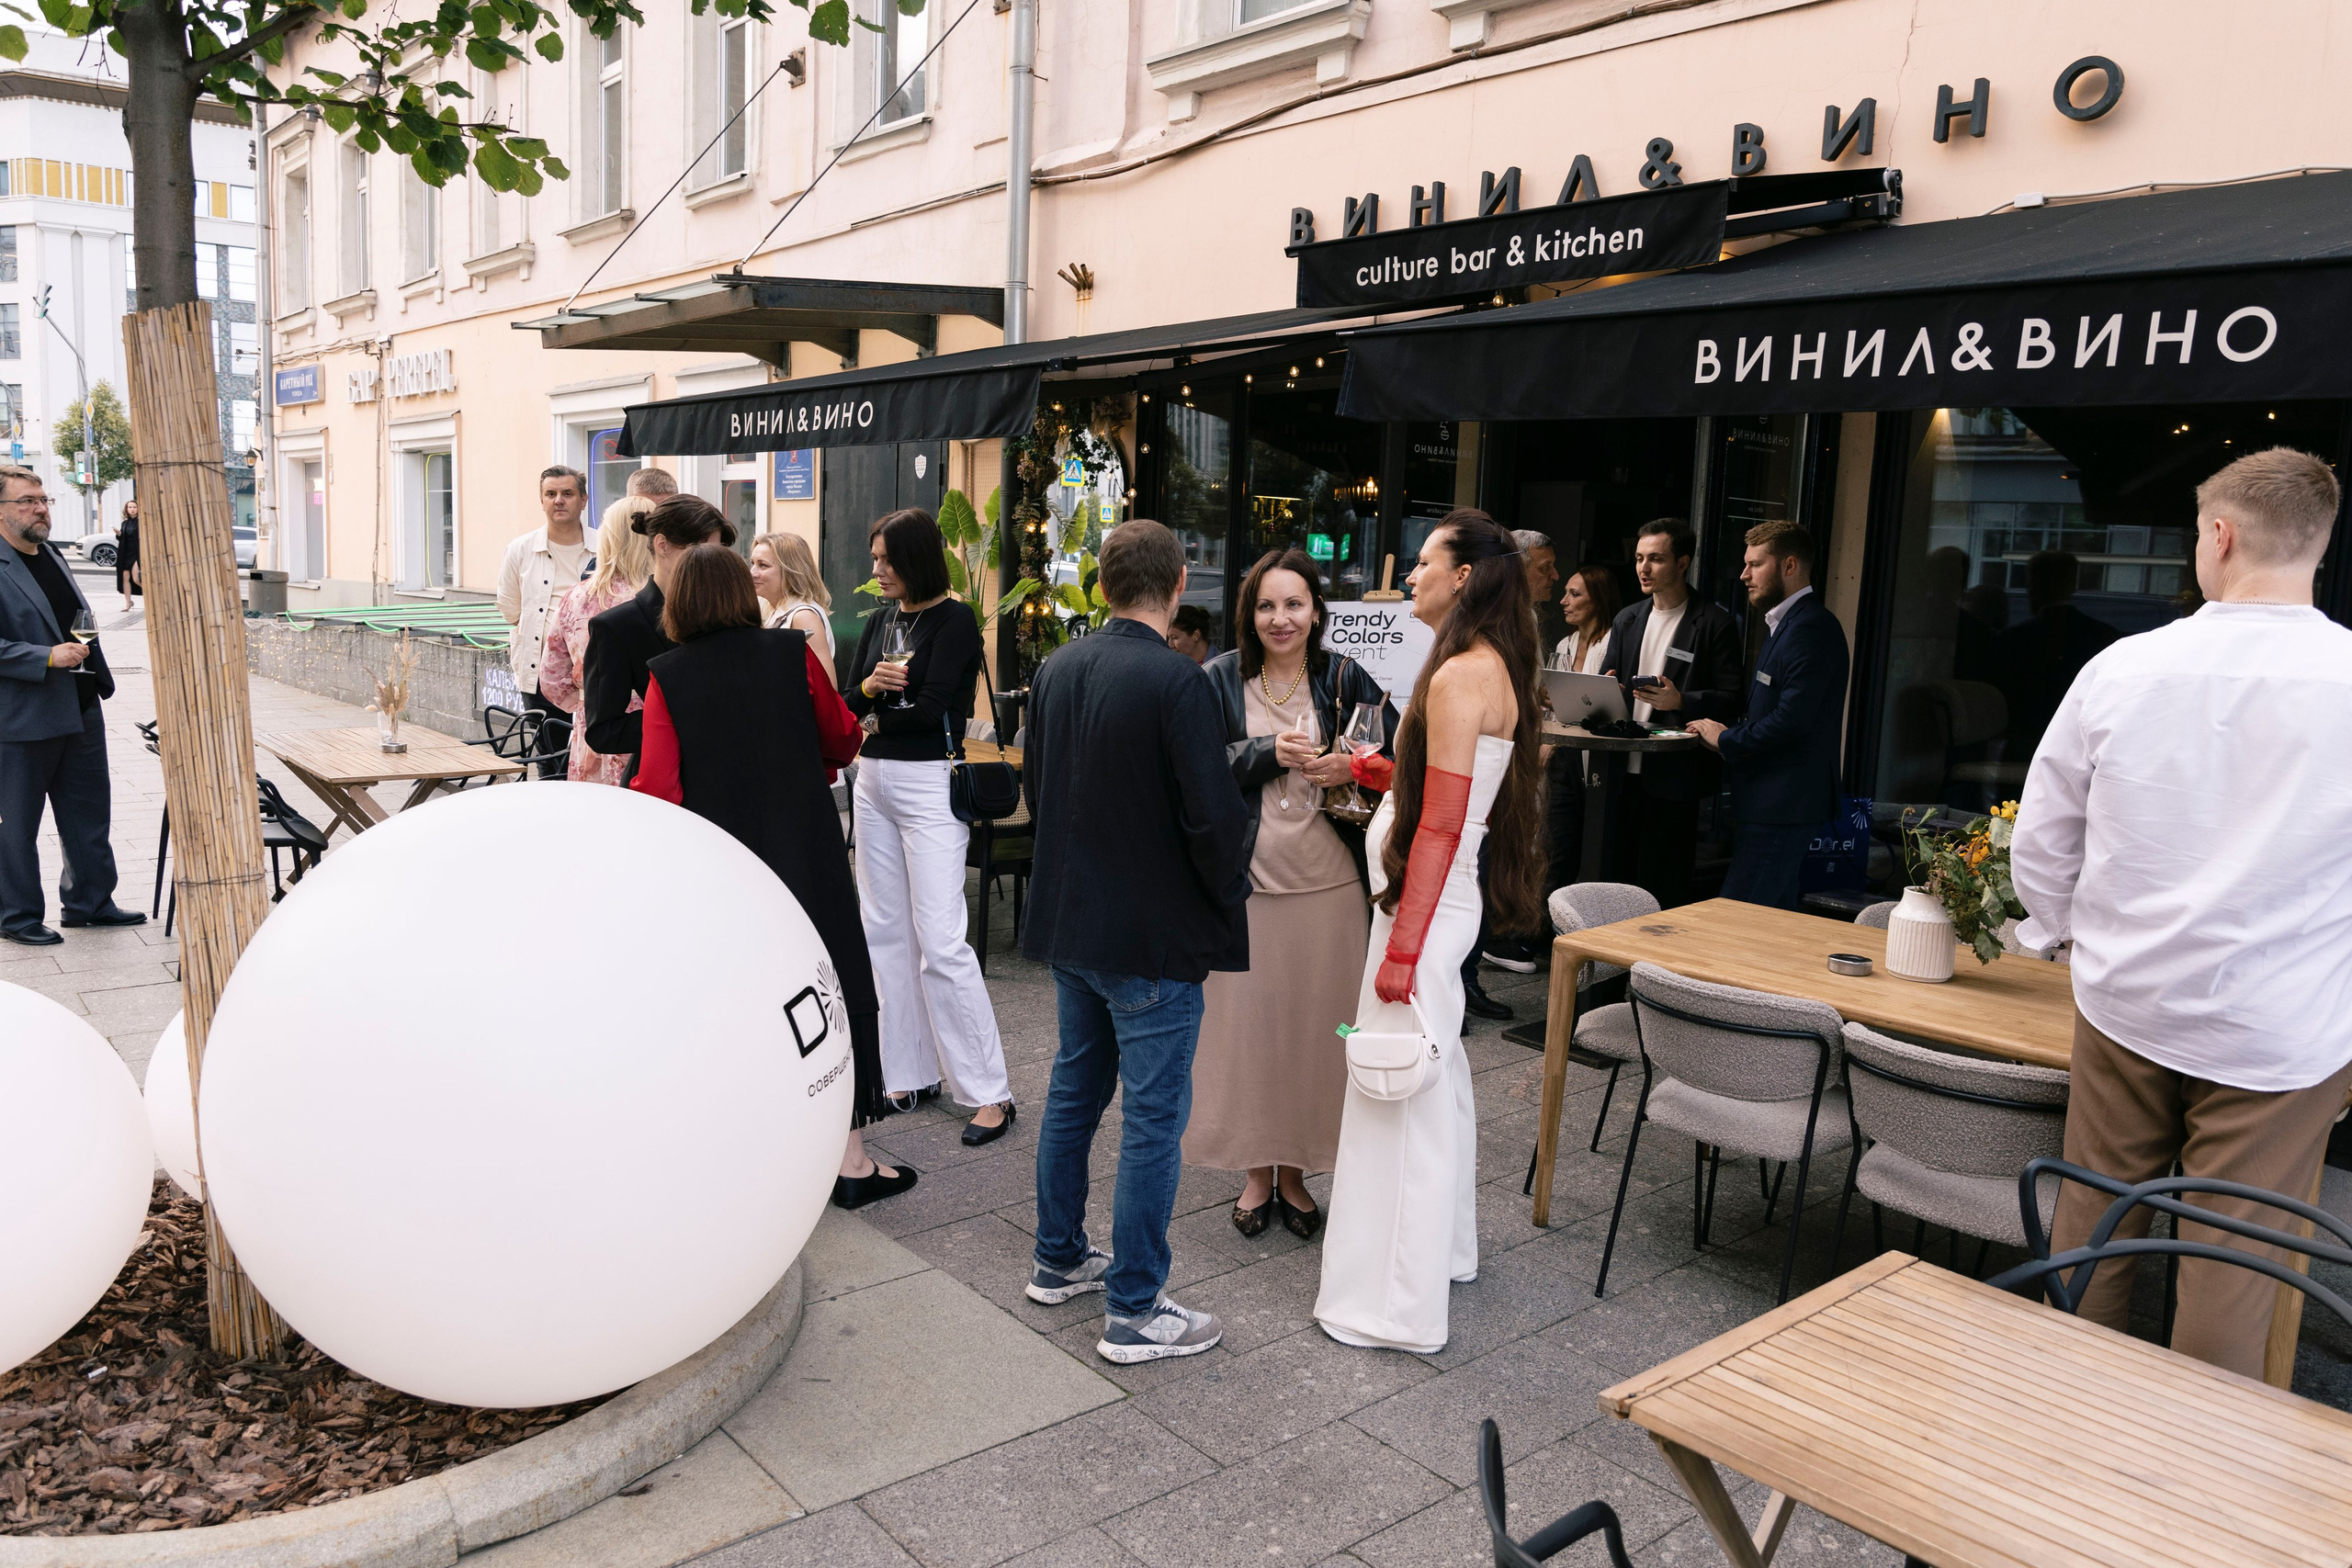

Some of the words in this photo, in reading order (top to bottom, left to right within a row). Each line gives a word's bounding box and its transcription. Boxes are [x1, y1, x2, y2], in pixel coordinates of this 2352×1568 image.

[1290, 55, 2124, 246] ВИНИЛ&ВИНО
[1356, 255, 1439, 287] culture
[1451, 247, 1496, 275] bar
[1506, 235, 1525, 266] &
[1535, 227, 1644, 263] kitchen
[1694, 306, 2278, 384] ВИНИЛ&ВИНО
[730, 400, 874, 437] ВИНИЛ&ВИНО
[1327, 611, 1396, 630] Trendy
[1331, 628, 1404, 644] Colors
[1335, 645, 1387, 660] vent
[485, 667, 521, 693] КАЛЬЯ
[481, 686, 503, 707] 1200
